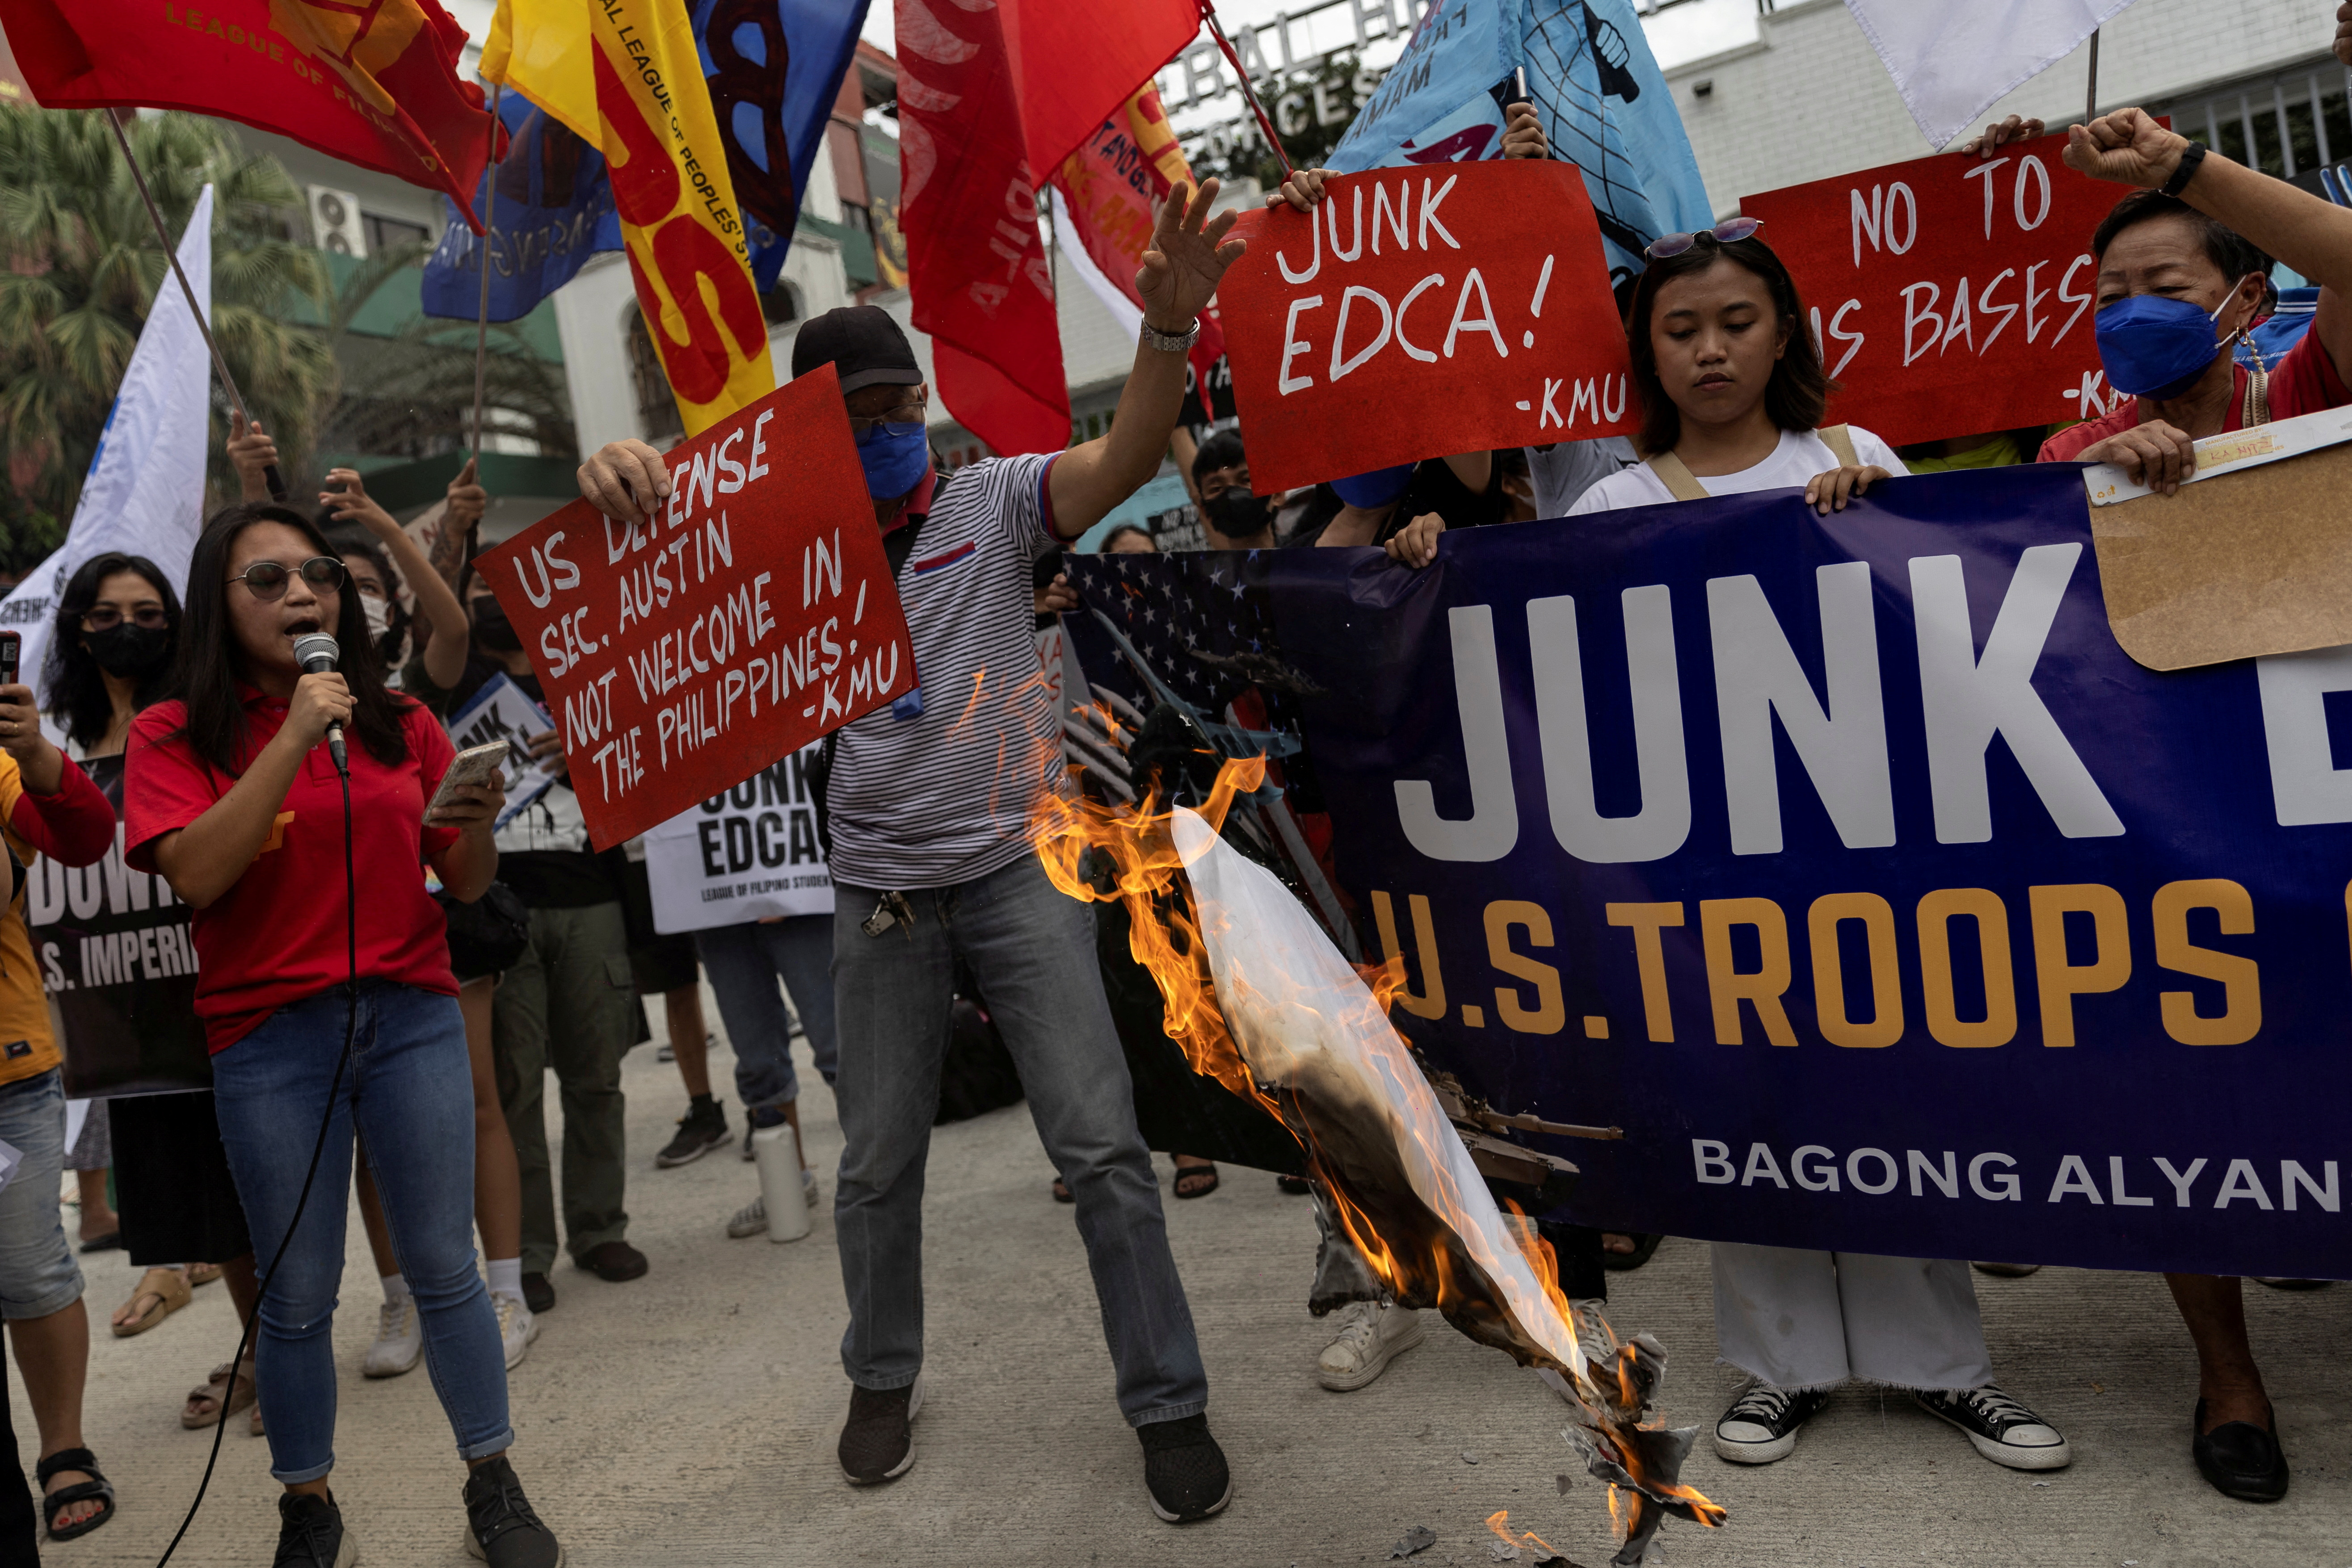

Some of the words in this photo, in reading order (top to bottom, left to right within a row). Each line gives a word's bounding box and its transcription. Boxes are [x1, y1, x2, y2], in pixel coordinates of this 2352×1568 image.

[165, 2, 284, 64] LEAGUE
[293, 58, 323, 85] OF
[618, 26, 673, 114] LEAGUE
[671, 115, 684, 143] OF
[1182, 12, 1325, 106] RAL
[1207, 69, 1382, 159] ORCES
[1276, 174, 1460, 283] JUNK
[1851, 181, 1917, 268] NO
[1963, 155, 2050, 240] TO
[1279, 254, 1553, 395] EDCA!
[1900, 254, 2092, 367] BASES
[1516, 373, 1625, 429] -KMU
[2205, 430, 2253, 446] MANUFACTURED
[513, 531, 580, 608] US
[541, 606, 610, 678] SEC.
[619, 509, 732, 633] AUSTIN
[565, 667, 617, 756] NOT
[628, 571, 775, 704] WELCOME
[804, 527, 842, 610] IN
[593, 725, 644, 803] THE
[657, 579, 866, 772] PHILIPPINES!
[802, 640, 897, 727] -KMU
[1393, 542, 2126, 863] JUNK
[736, 883, 747, 896] OF
[1691, 1138, 2021, 1200] BAGONG
[2047, 1154, 2340, 1213] ALYAN
